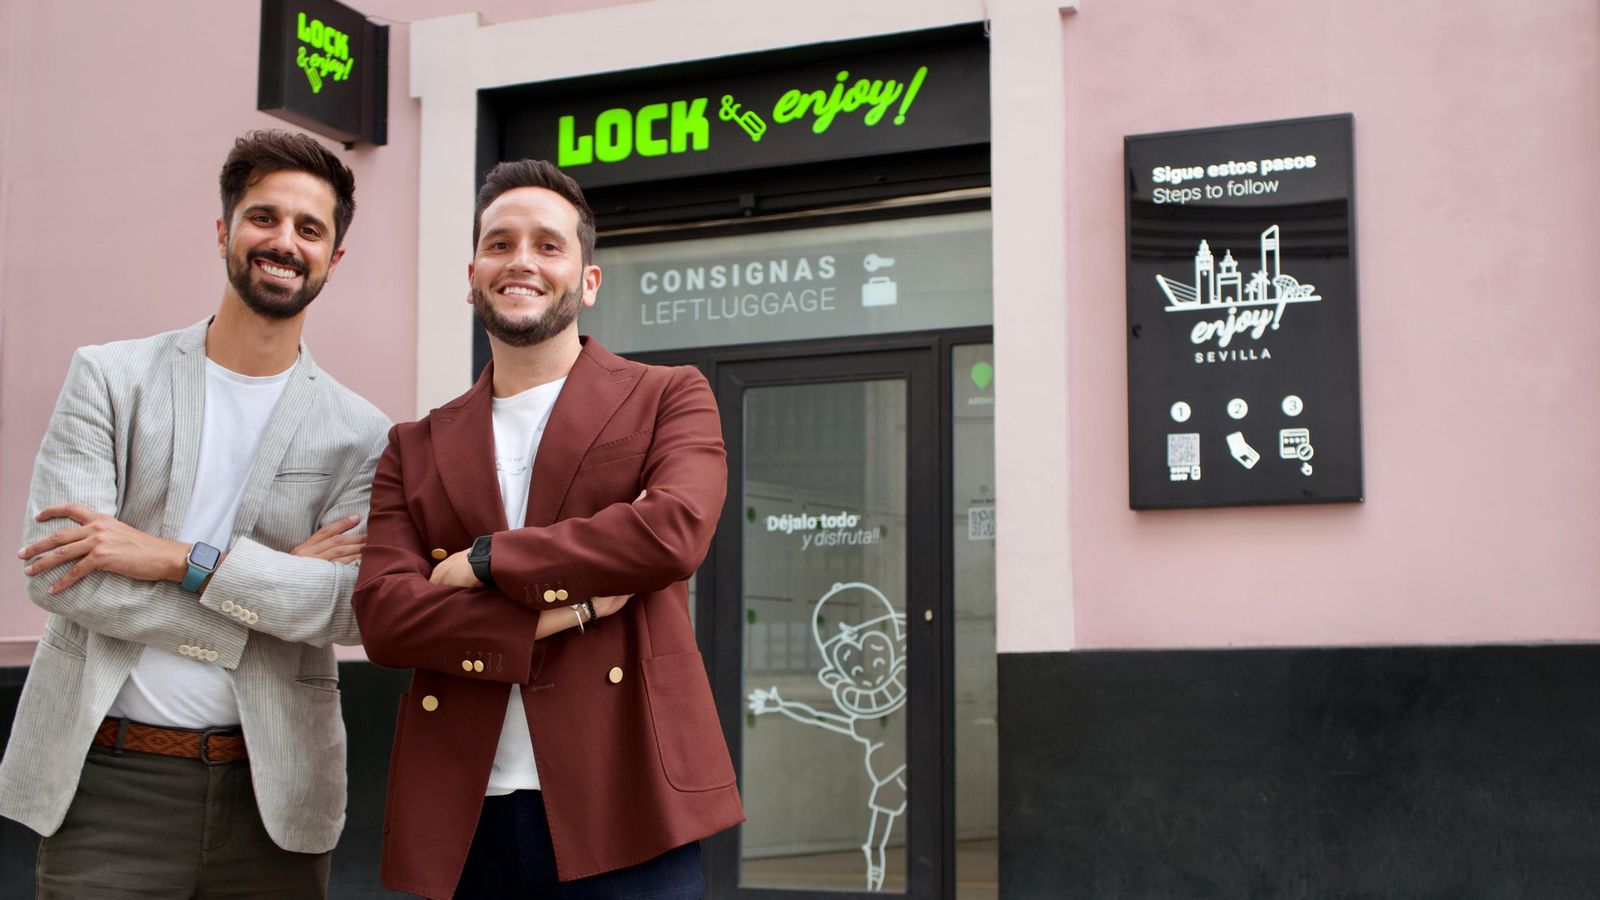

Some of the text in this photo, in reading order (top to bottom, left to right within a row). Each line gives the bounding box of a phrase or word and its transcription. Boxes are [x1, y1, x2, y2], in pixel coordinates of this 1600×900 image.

[298, 12, 348, 60] LOCK
[309, 53, 354, 81] enjoy!
[558, 98, 709, 167] LOCK
[773, 66, 928, 134] enjoy!
[1152, 154, 1317, 184] Sigue estos pasos
[1152, 180, 1279, 204] Steps to follow
[640, 256, 836, 294] CONSIGNAS
[641, 287, 836, 325] LEFTLUGGAGE
[1190, 298, 1284, 348] enjoy!
[1195, 348, 1271, 363] SEVILLA
[766, 511, 858, 534] Déjalo todo
[801, 527, 881, 550] y disfruta!!
